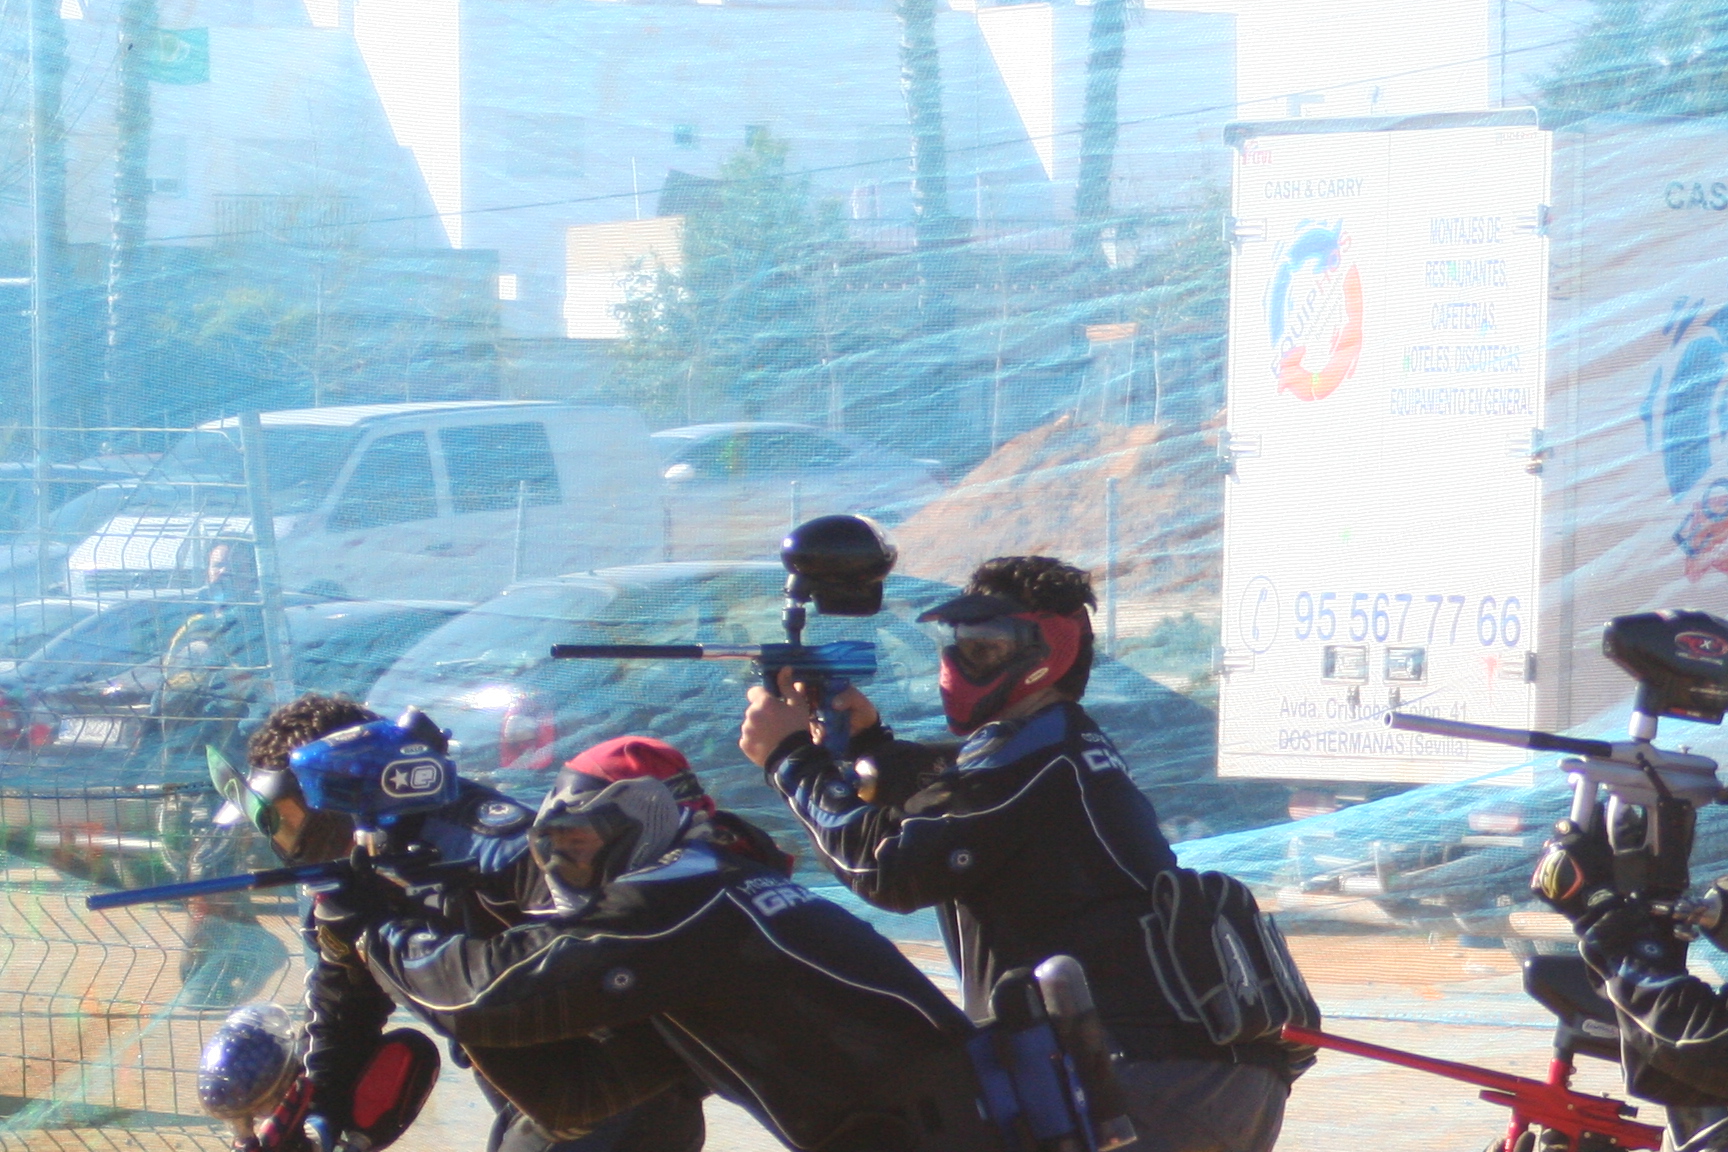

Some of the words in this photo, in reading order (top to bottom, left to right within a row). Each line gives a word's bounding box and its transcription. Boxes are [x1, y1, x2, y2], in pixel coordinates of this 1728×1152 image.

[1264, 180, 1300, 200] CASH
[1304, 180, 1314, 198] &
[1317, 177, 1364, 198] CARRY
[1294, 591, 1337, 641] 95
[1350, 593, 1413, 642] 567
[1424, 595, 1466, 645] 77
[1477, 596, 1522, 647] 66
[1278, 729, 1312, 751] DOS
[1316, 730, 1405, 754] HERMANAS
[1410, 733, 1470, 759] (Sevilla)
